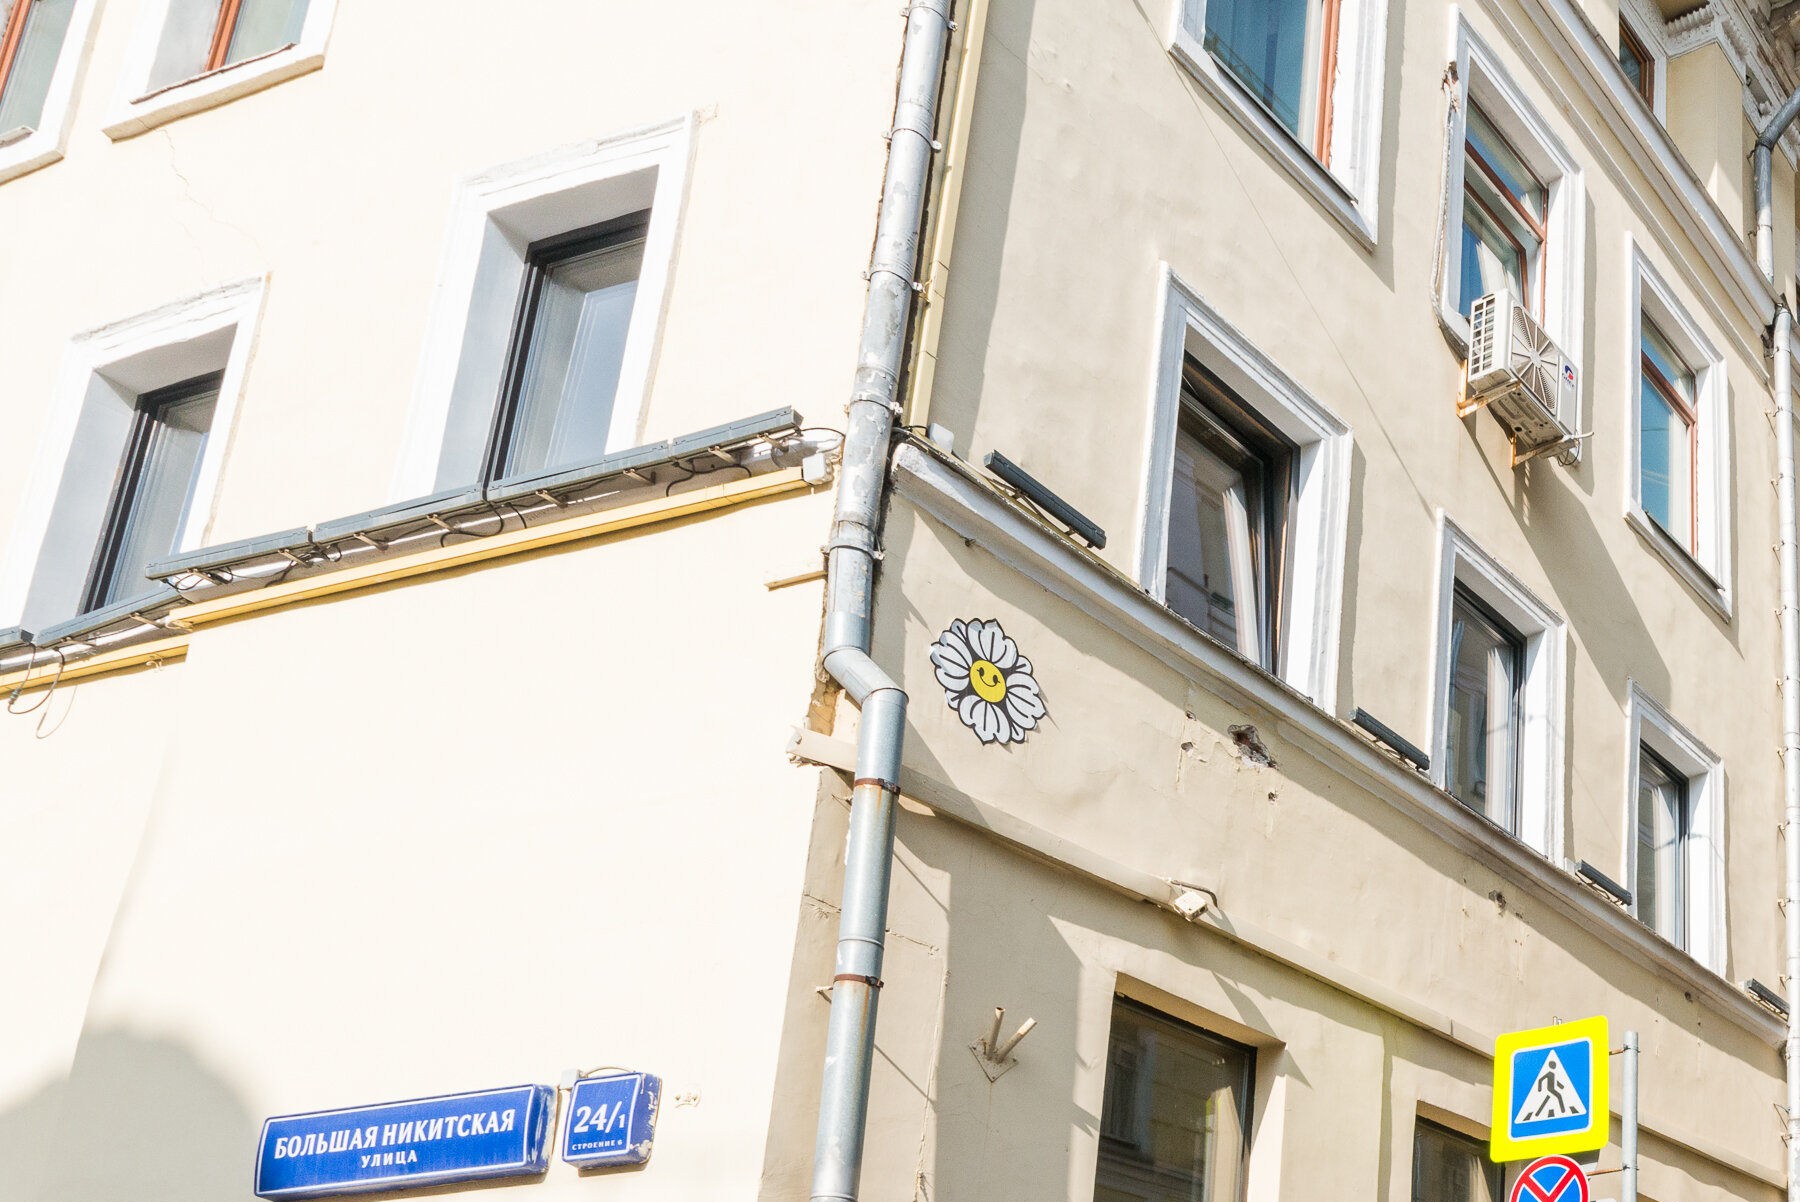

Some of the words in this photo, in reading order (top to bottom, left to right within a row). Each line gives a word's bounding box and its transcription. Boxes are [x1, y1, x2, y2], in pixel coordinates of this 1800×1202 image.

[573, 1100, 626, 1133] 24/1
[274, 1126, 379, 1160] БОЛЬШАЯ
[381, 1108, 516, 1146] НИКИТСКАЯ
[571, 1139, 616, 1151] СТРОЕНИЕ
[361, 1149, 418, 1169] УЛИЦА
